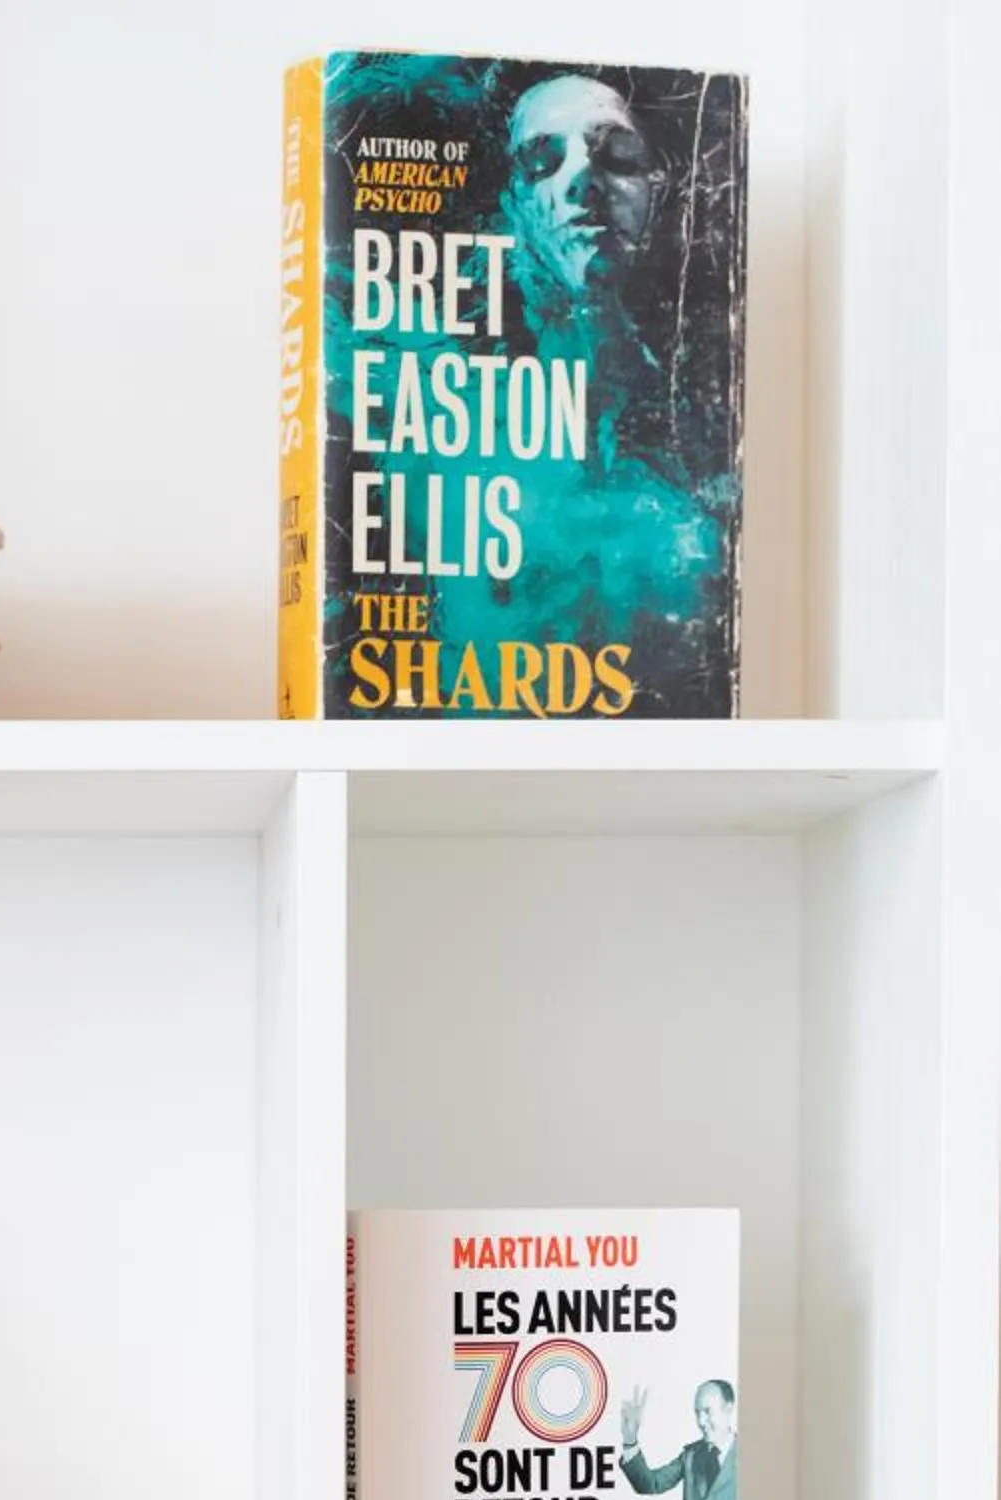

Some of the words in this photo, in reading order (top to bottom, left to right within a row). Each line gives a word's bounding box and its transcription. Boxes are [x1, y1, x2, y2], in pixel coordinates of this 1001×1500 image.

[353, 161, 468, 188] AMERICAN
[357, 136, 437, 161] AUTHOR
[443, 141, 470, 161] OF
[353, 189, 442, 214] PSYCHO
[353, 228, 515, 337] BRET
[280, 199, 305, 456] SHARDS
[352, 349, 587, 460] EASTON
[351, 471, 524, 580] ELLIS
[353, 592, 430, 633] THE
[348, 637, 634, 719] SHARDS
[345, 1236, 356, 1278] YOU
[453, 1236, 579, 1269] MARTIAL
[585, 1236, 638, 1267] YOU
[345, 1283, 356, 1375] MARTIAL
[454, 1290, 520, 1335] LES
[527, 1284, 677, 1334] ANNÉES
[454, 1338, 609, 1443] 70
[345, 1397, 357, 1478] RETOUR
[454, 1447, 555, 1494] SONT
[569, 1446, 616, 1490] DE
